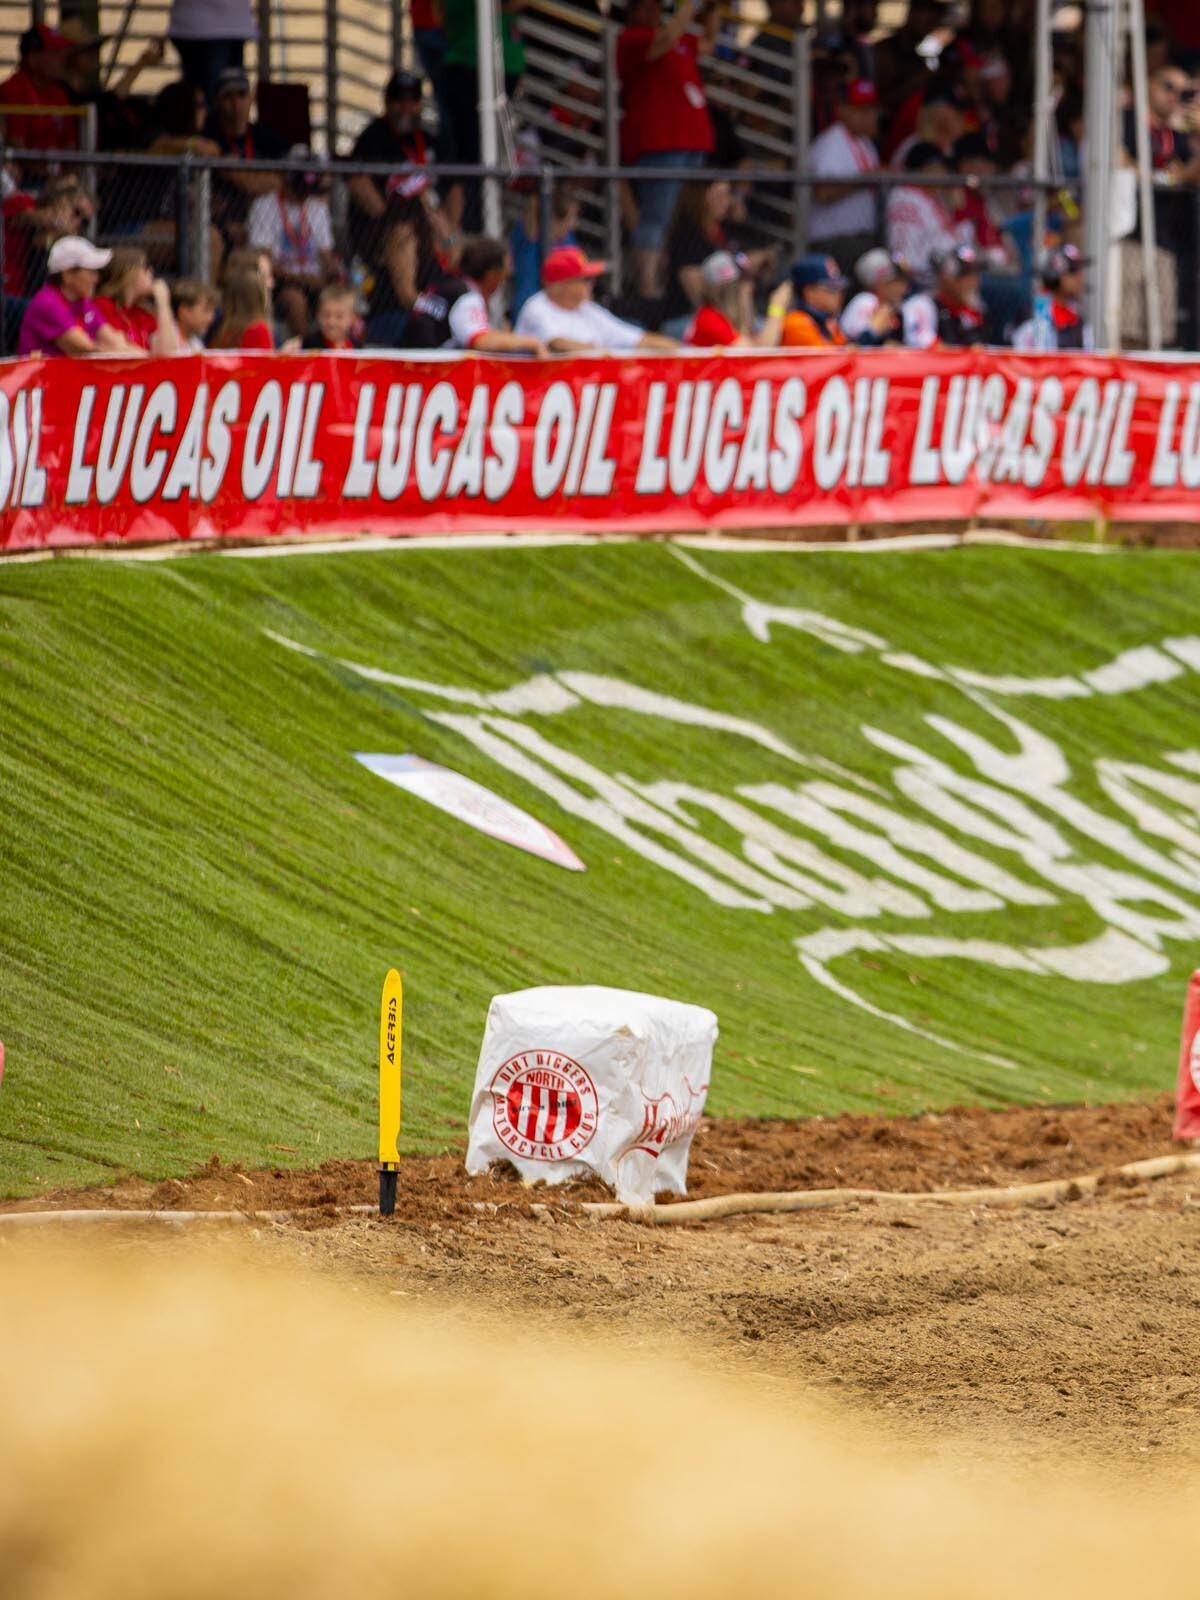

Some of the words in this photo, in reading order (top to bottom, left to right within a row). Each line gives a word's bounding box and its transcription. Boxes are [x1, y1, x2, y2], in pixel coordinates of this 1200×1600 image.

[65, 382, 241, 503] LUCAS
[242, 381, 325, 500] OIL
[343, 382, 525, 501] LUCAS
[532, 381, 617, 498] OIL
[635, 376, 807, 494] LUCAS
[813, 376, 891, 490] OIL
[910, 374, 1059, 488] LUCAS
[1060, 377, 1138, 486] OIL
[387, 997, 397, 1065] ACERBIS
[500, 1055, 529, 1083] DIRT
[536, 1053, 592, 1096] DIGGERS
[525, 1070, 566, 1090] NORTH
[569, 1112, 595, 1150] CLUB
